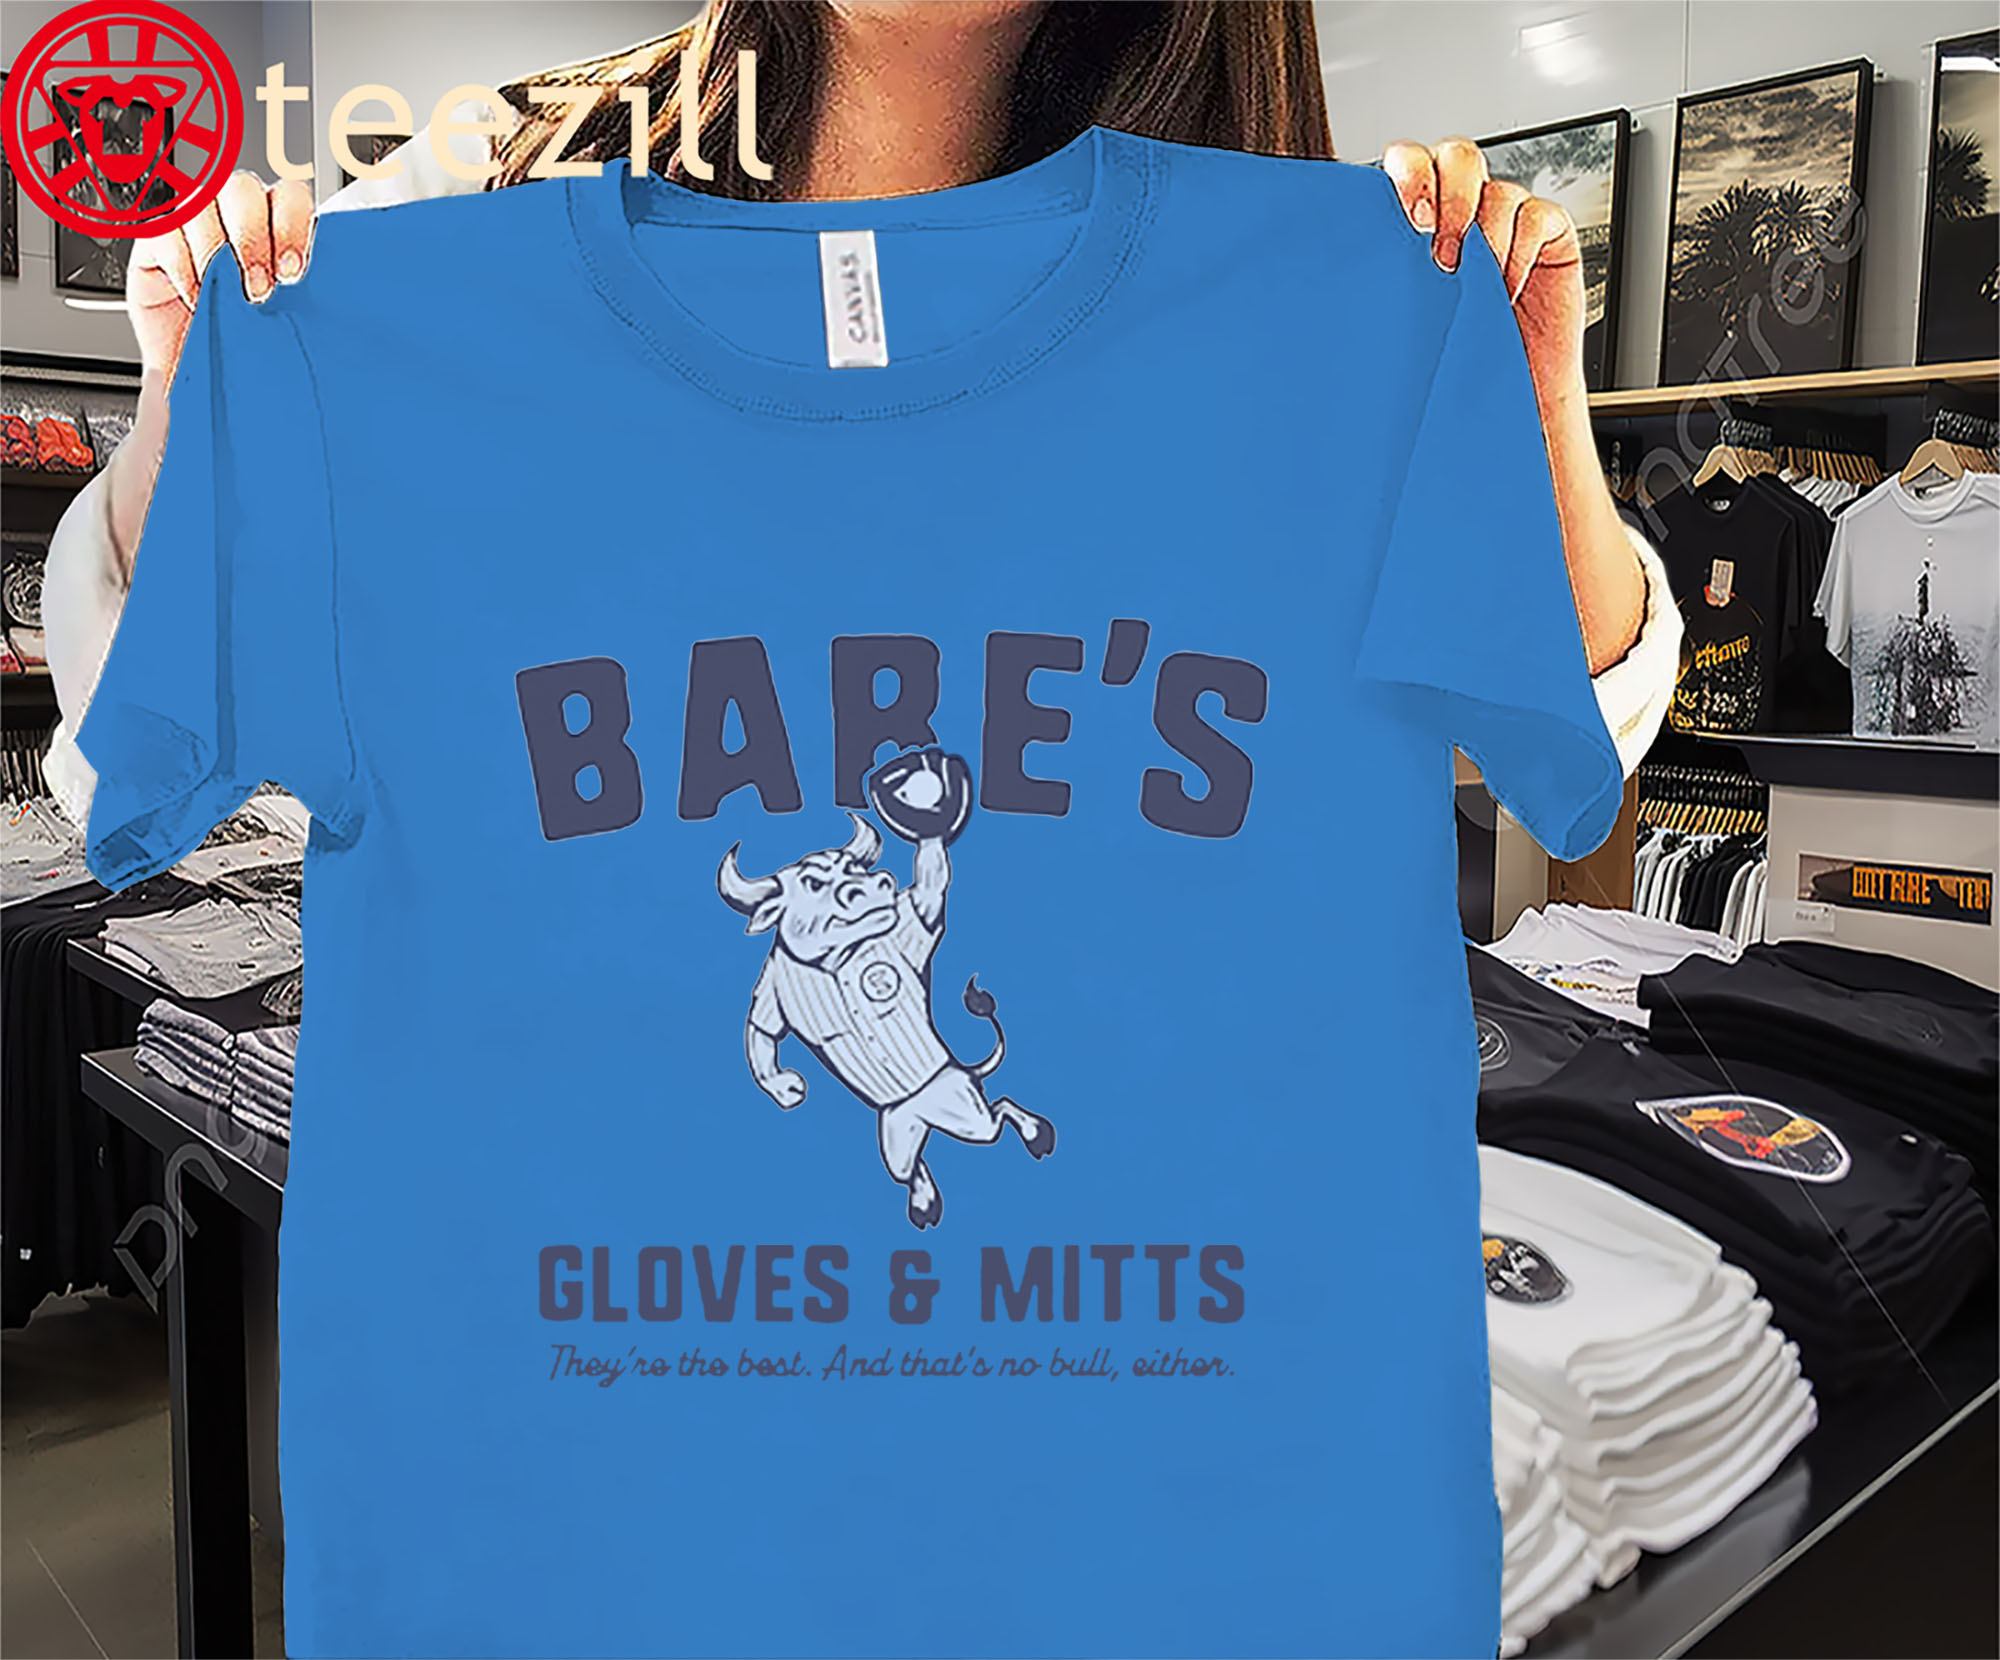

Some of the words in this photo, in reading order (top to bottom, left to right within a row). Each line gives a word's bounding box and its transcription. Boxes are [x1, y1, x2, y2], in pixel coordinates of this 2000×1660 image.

[515, 618, 1269, 841] BABE'S
[538, 1244, 849, 1323] GLOVES
[889, 1249, 940, 1324] &
[980, 1244, 1245, 1323] MITTS
[550, 1344, 671, 1388] They're
[678, 1347, 729, 1377] the
[737, 1348, 811, 1377] best.
[821, 1343, 894, 1381] And
[900, 1346, 993, 1377] that's
[998, 1357, 1042, 1377] no
[1049, 1347, 1119, 1382] bull,
[1132, 1347, 1235, 1377] either.
